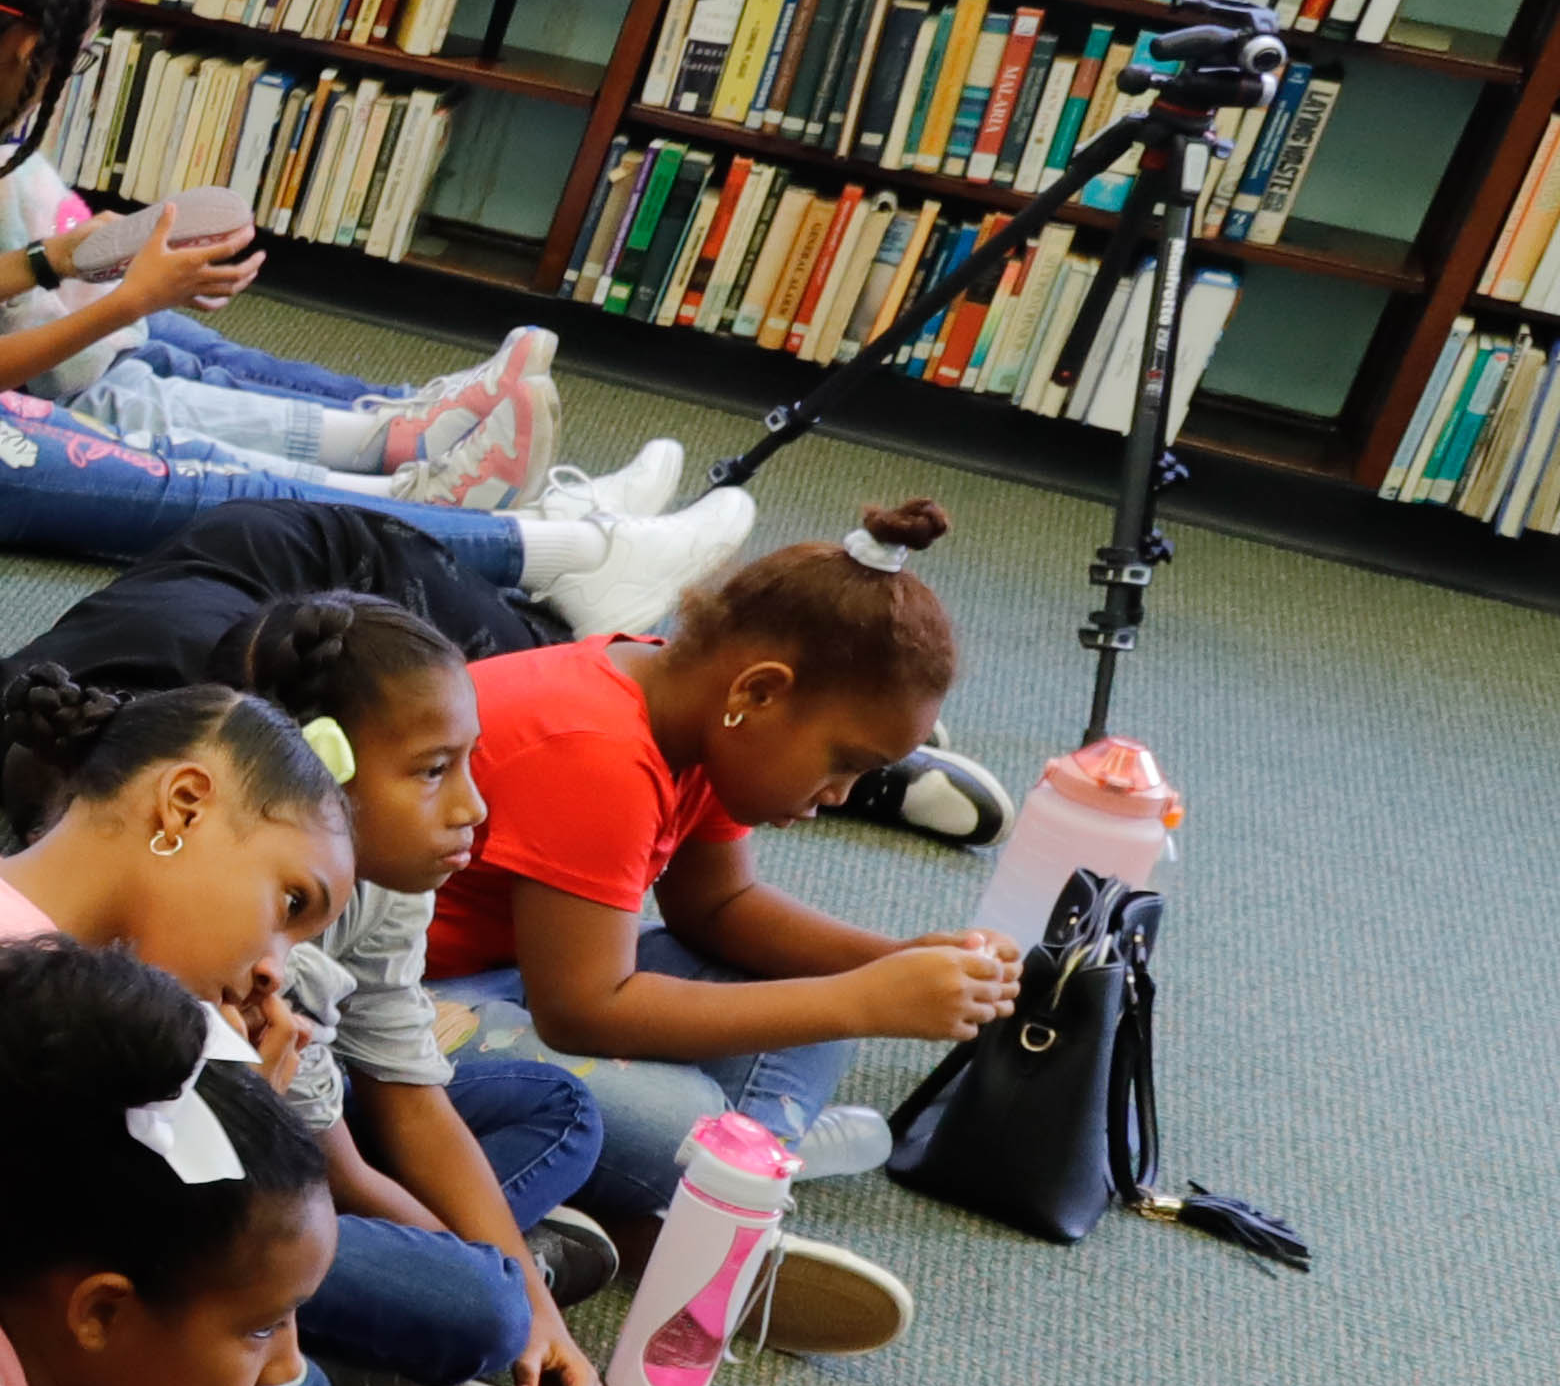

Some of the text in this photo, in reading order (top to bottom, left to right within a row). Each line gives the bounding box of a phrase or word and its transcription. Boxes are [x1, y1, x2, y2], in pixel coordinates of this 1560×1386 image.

[984, 63, 1021, 137] MALARIA
[1269, 85, 1333, 196] LAYING WASTE
[1164, 237, 1186, 326] Manfrotto
